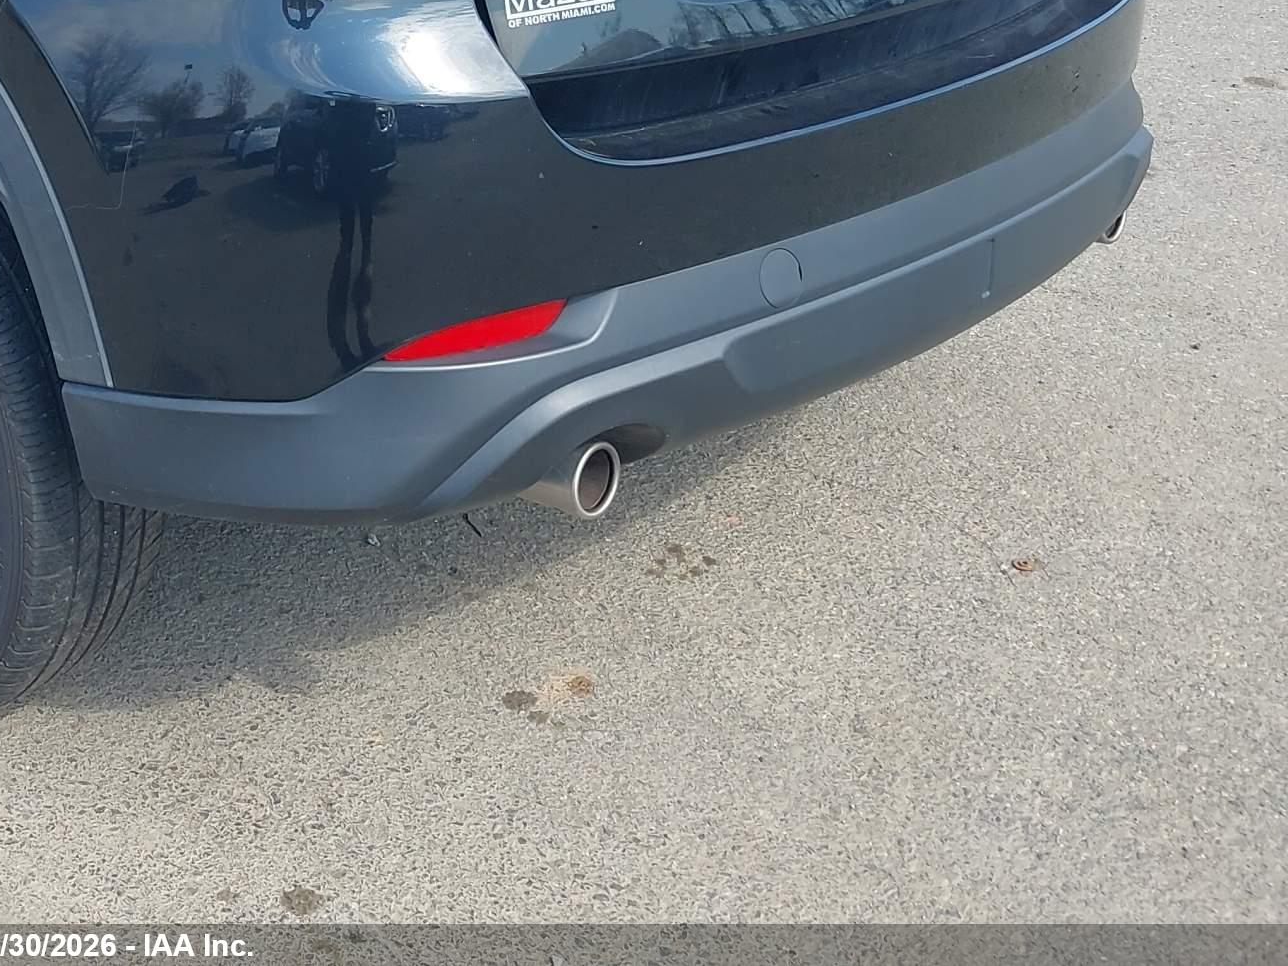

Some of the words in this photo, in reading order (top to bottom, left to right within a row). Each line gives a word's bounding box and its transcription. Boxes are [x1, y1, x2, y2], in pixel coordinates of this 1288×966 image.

[508, 18, 524, 28] OF
[525, 11, 560, 26] NORTH
[561, 2, 616, 20] MIAMI.COM
